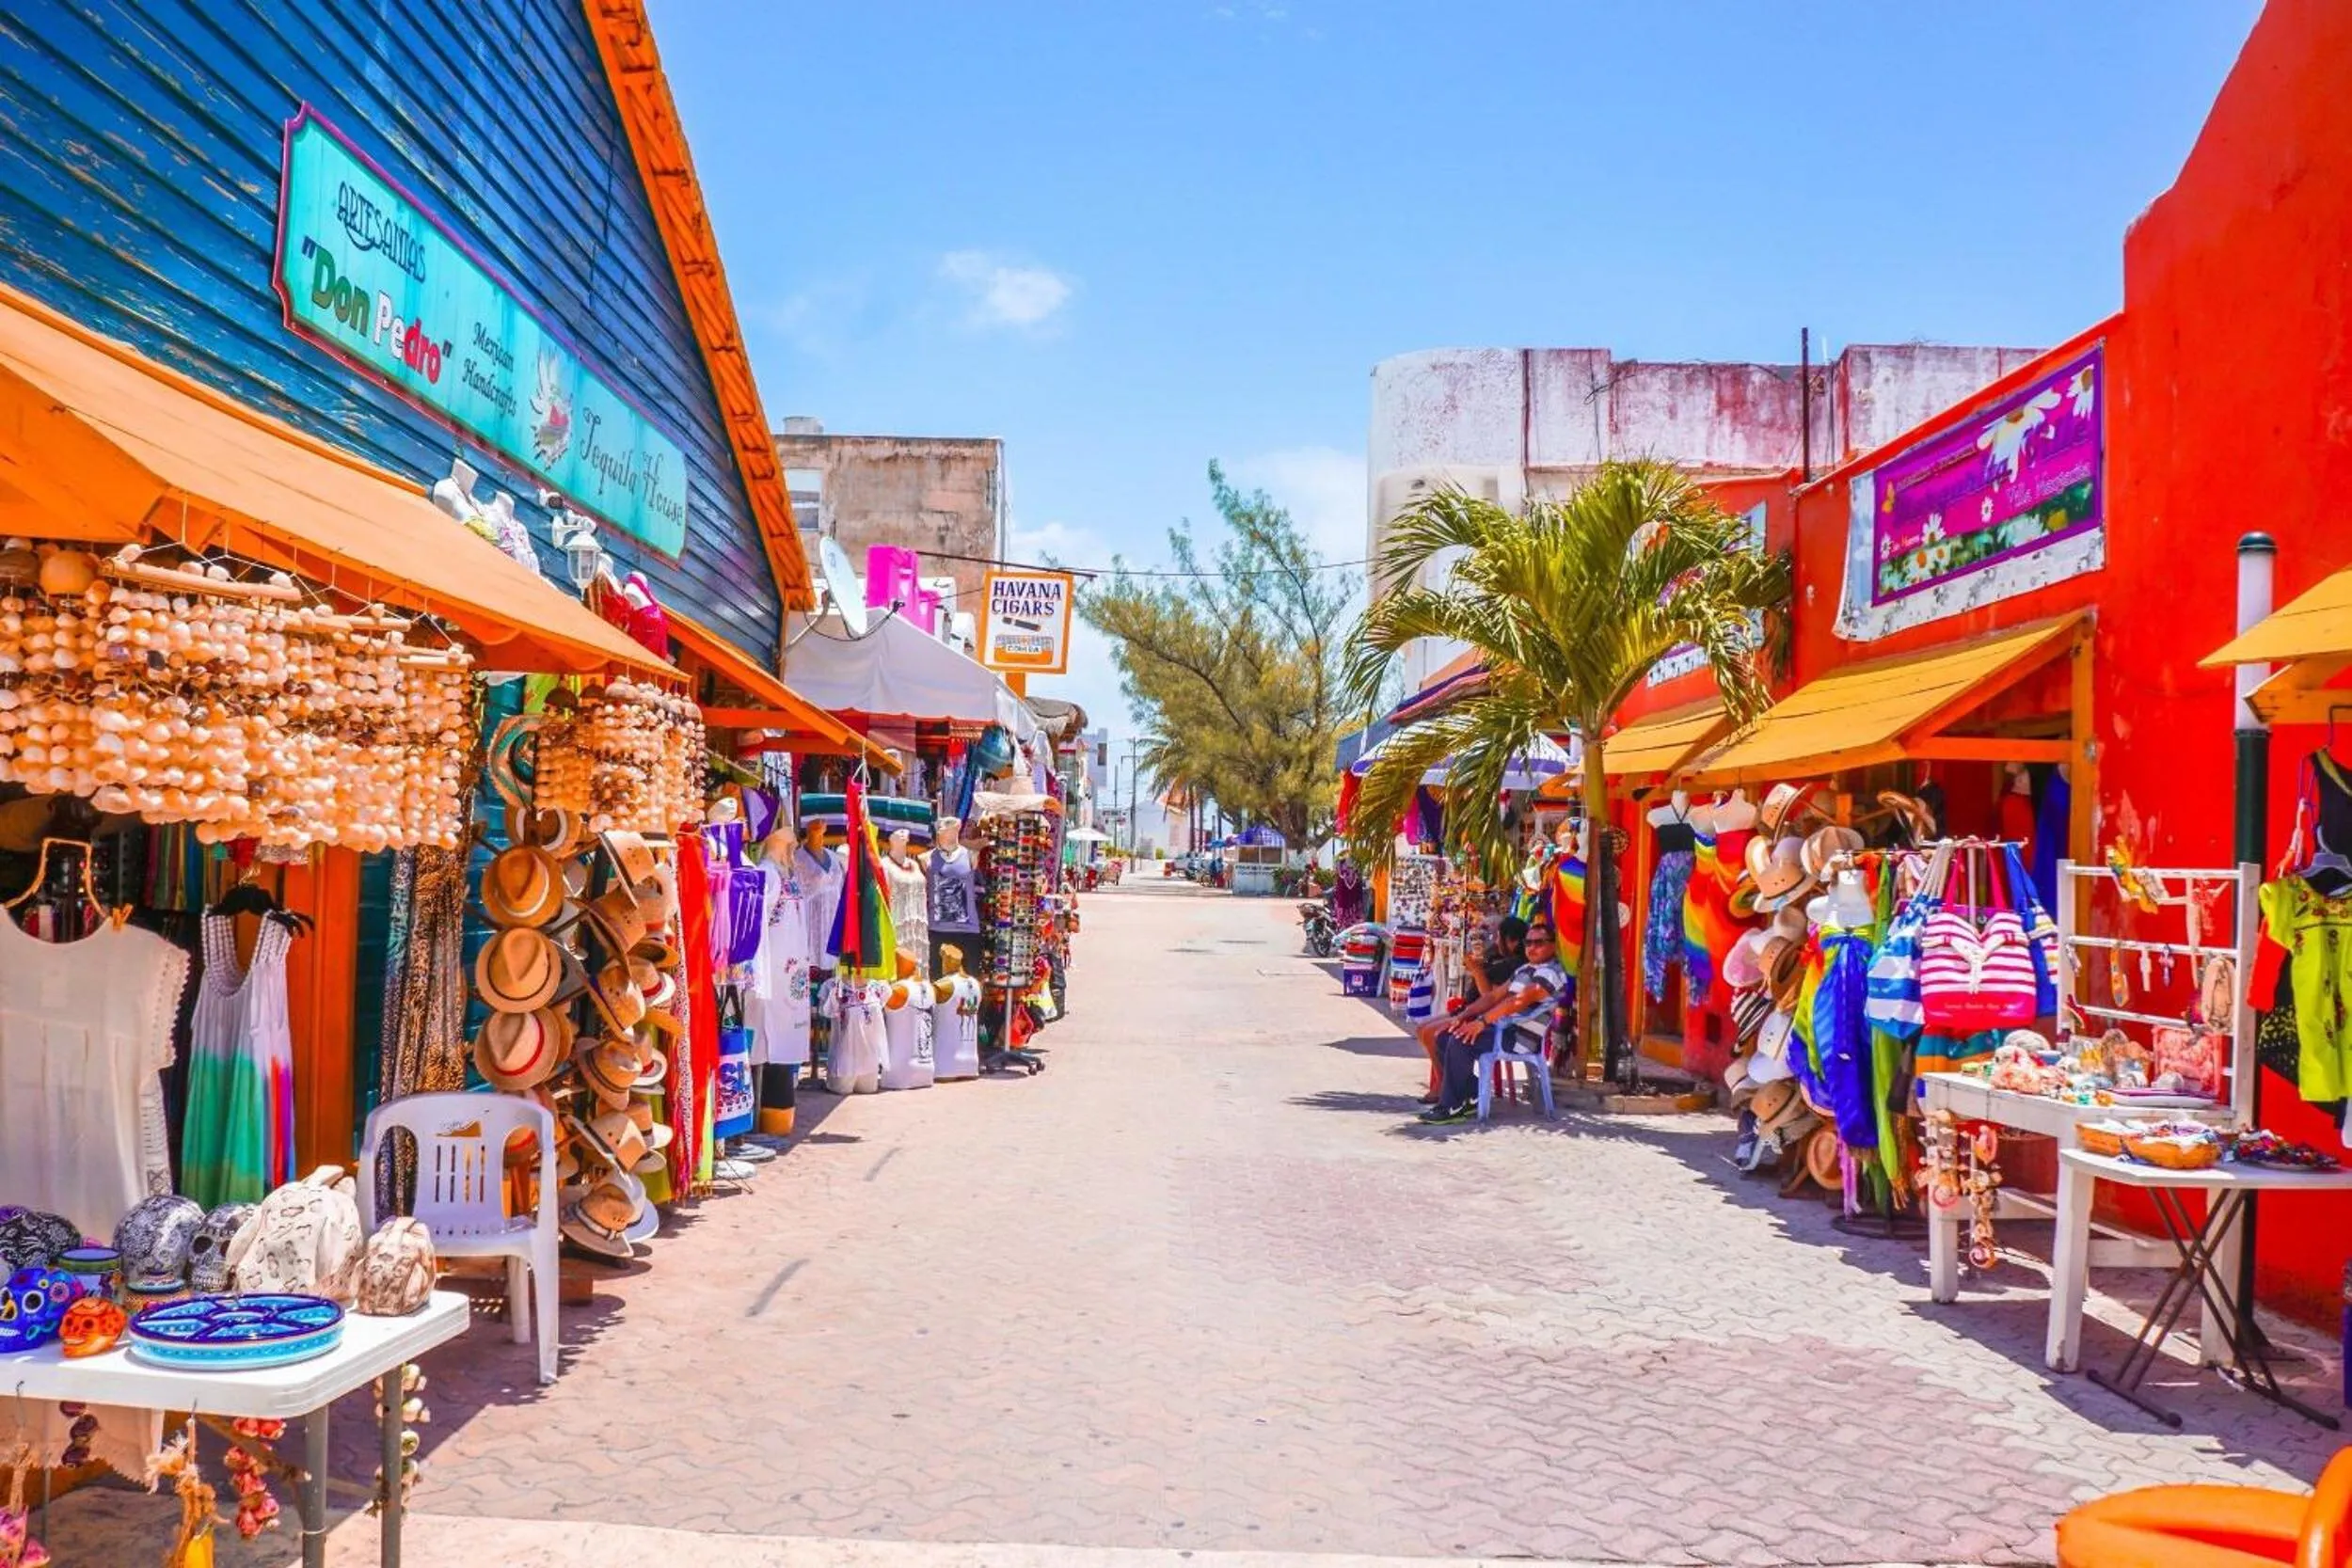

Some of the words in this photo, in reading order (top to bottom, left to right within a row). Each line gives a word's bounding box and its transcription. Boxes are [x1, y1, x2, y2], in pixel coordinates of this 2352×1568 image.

[337, 181, 426, 284] ARTESANIAS
[301, 235, 371, 338] "Don
[373, 289, 453, 385] Pedro"
[472, 321, 515, 373] Mexican
[580, 406, 638, 496] Tequila
[642, 451, 684, 527] House
[992, 597, 1055, 616] CIGARS
[993, 580, 1061, 600] HAVANA
